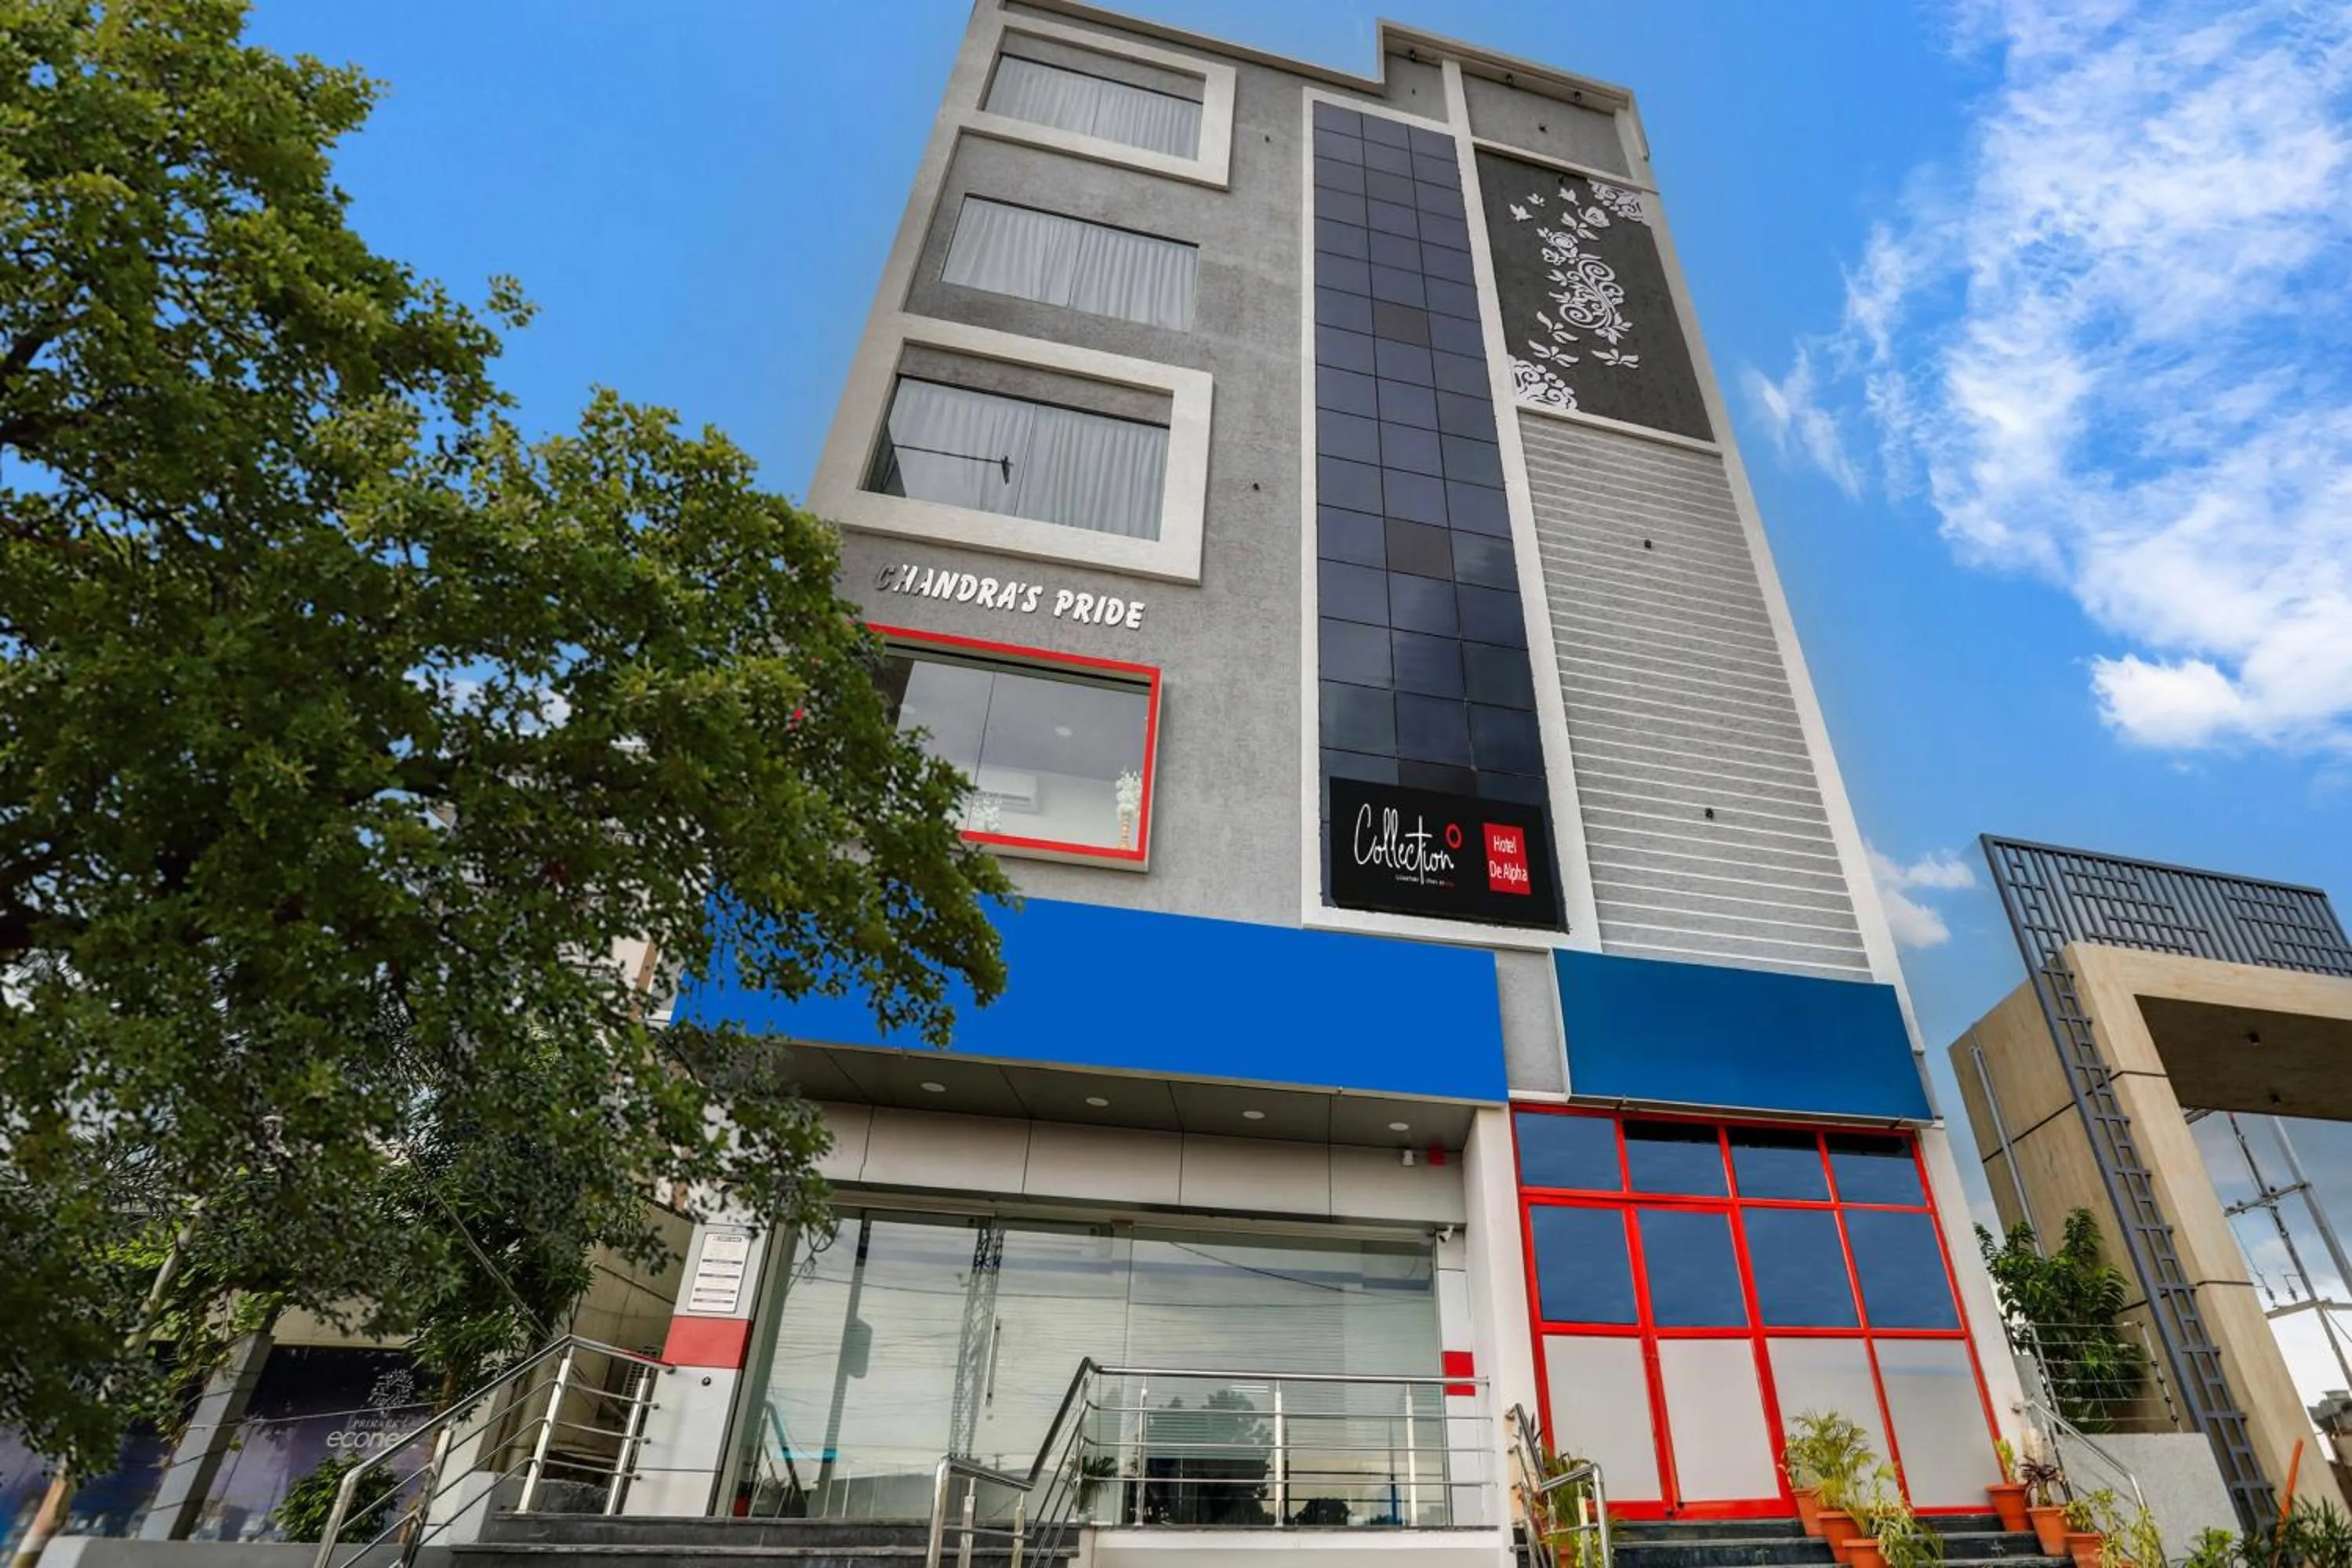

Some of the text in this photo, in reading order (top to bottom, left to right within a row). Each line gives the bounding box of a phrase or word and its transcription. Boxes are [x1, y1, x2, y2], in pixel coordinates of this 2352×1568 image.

[877, 563, 1146, 630] CHANDRA'S PRIDE
[1353, 802, 1455, 885] Collection
[1493, 834, 1517, 854] Hotel
[1489, 860, 1528, 885] De Alpha
